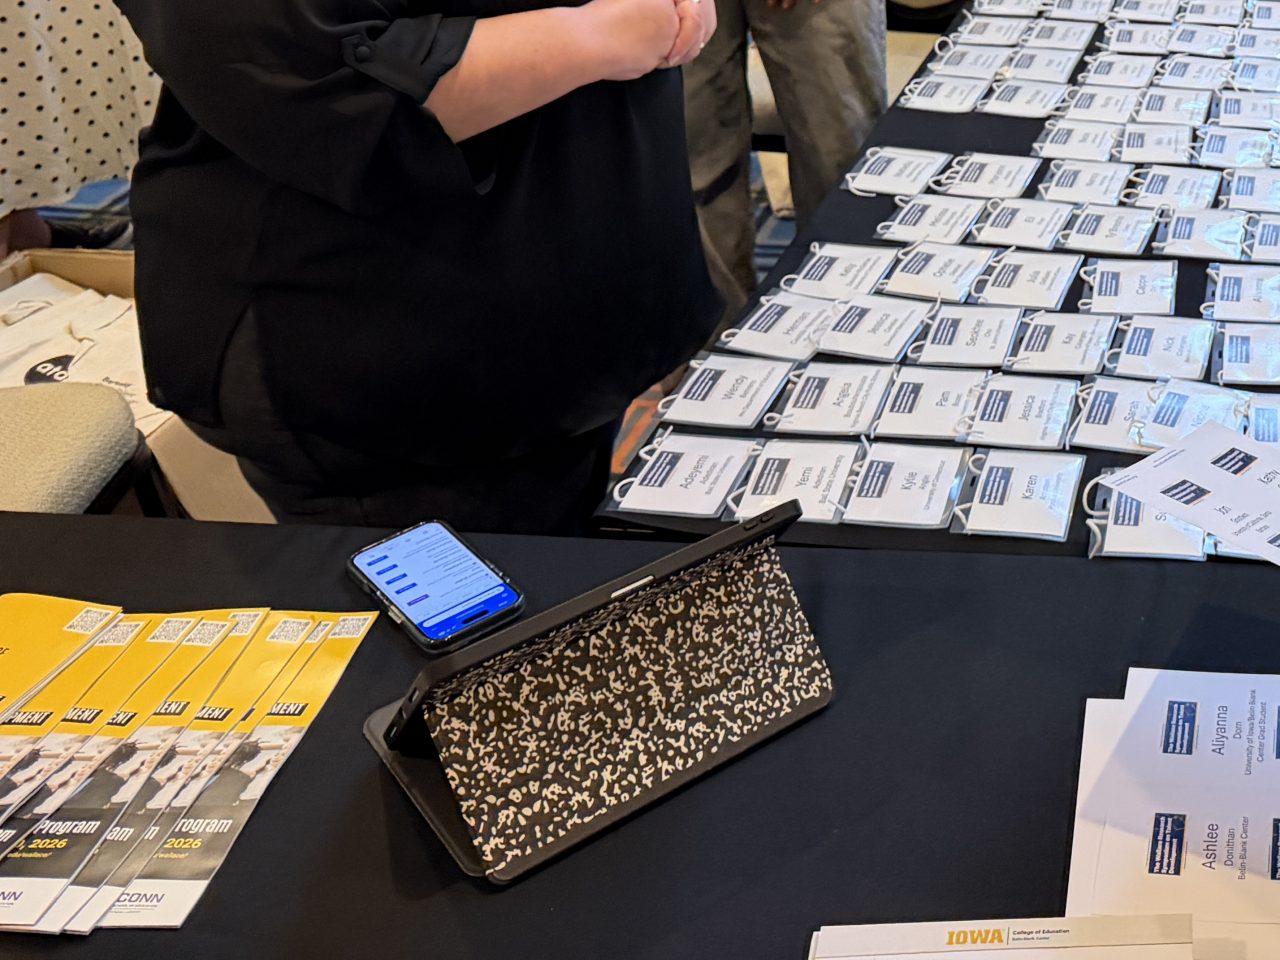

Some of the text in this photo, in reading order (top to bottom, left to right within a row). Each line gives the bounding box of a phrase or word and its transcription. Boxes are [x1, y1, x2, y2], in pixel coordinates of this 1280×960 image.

[680, 455, 709, 489] Adeyemi
[795, 466, 814, 489] Yemi
[1021, 474, 1038, 500] Karen
[1259, 701, 1267, 725] Student
[1211, 705, 1228, 755] Aliyanna
[1245, 744, 1255, 775] University
[1157, 817, 1166, 840] Research
[28, 838, 68, 849] 2026
[164, 838, 202, 849] 2026
[1155, 840, 1164, 861] Wallace
[1202, 823, 1219, 870] Ashlee
[1224, 828, 1235, 867] Donithan
[1238, 816, 1249, 880] Belin-Blank Center
[946, 928, 1003, 945] IOWA
